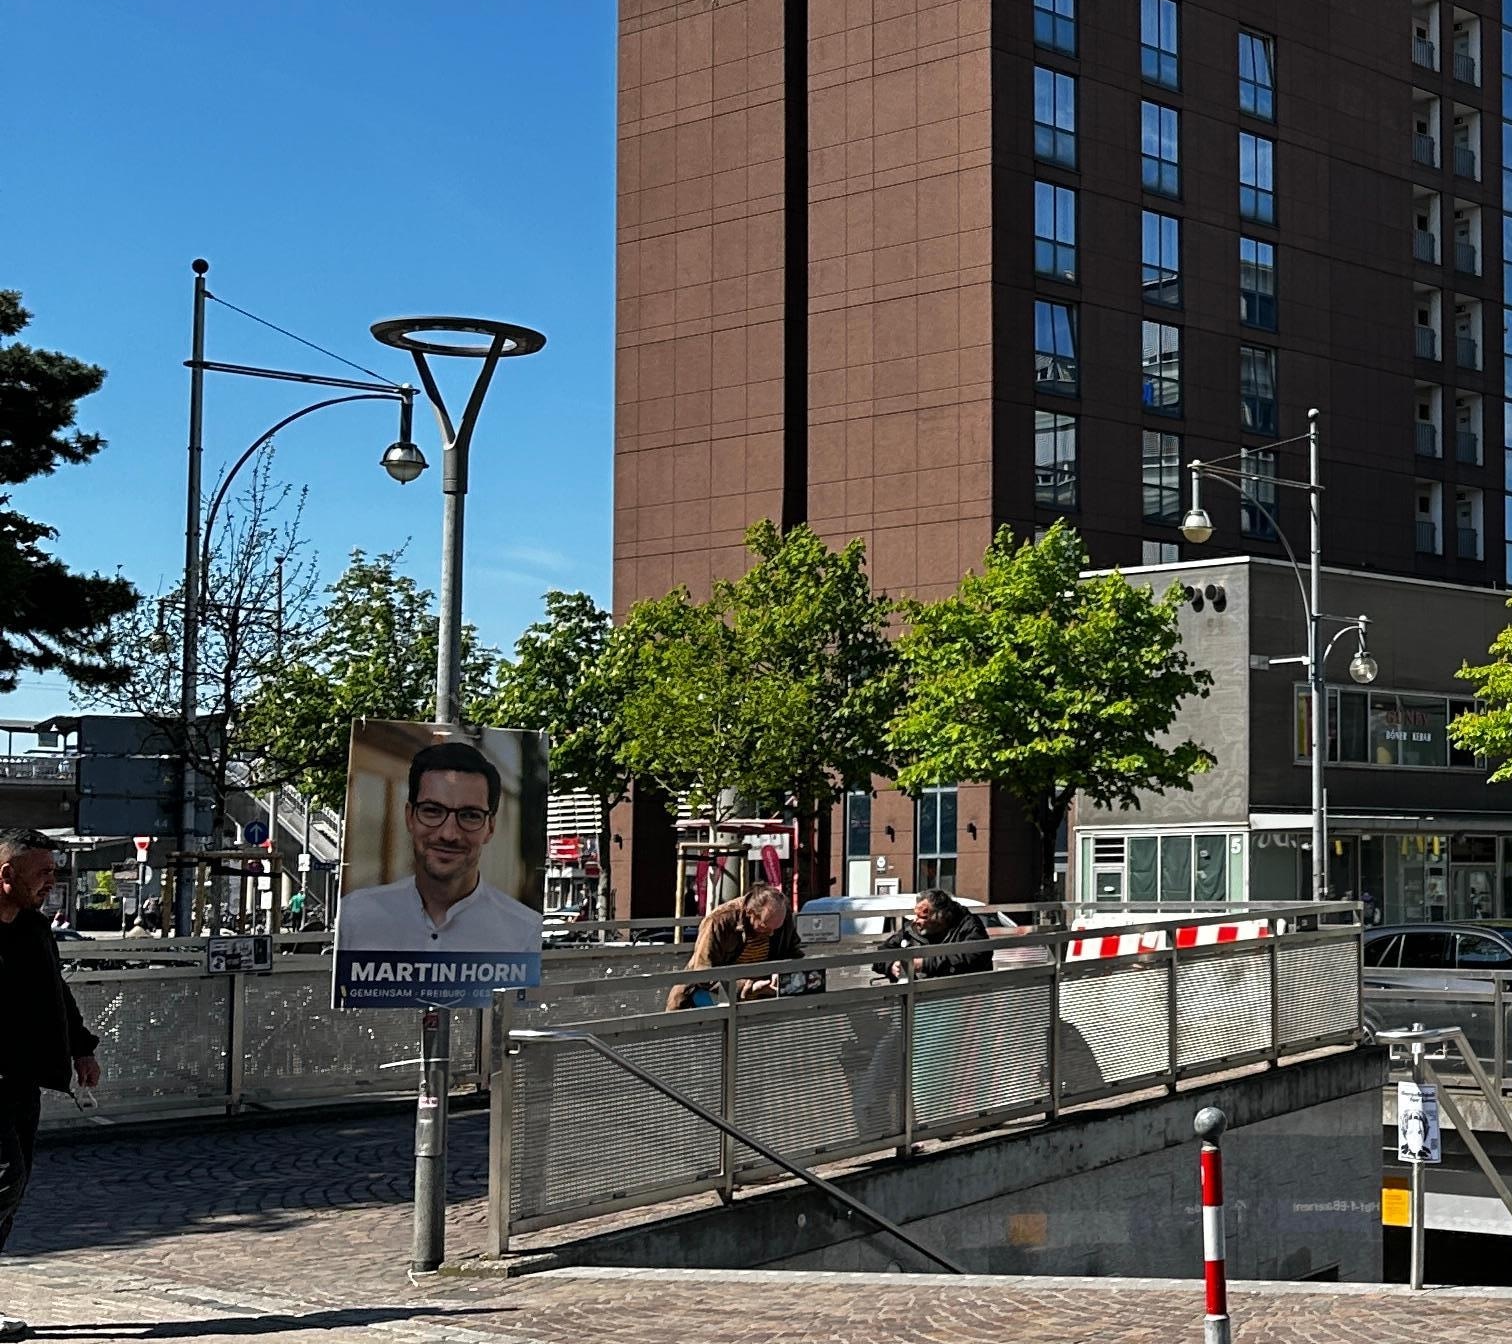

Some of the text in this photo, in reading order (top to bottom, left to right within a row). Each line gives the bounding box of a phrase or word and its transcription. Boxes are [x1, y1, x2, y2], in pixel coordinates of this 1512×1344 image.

[1230, 837, 1242, 854] 5
[350, 961, 527, 983] MARTIN HORN
[350, 988, 412, 998] GEMEINSAM
